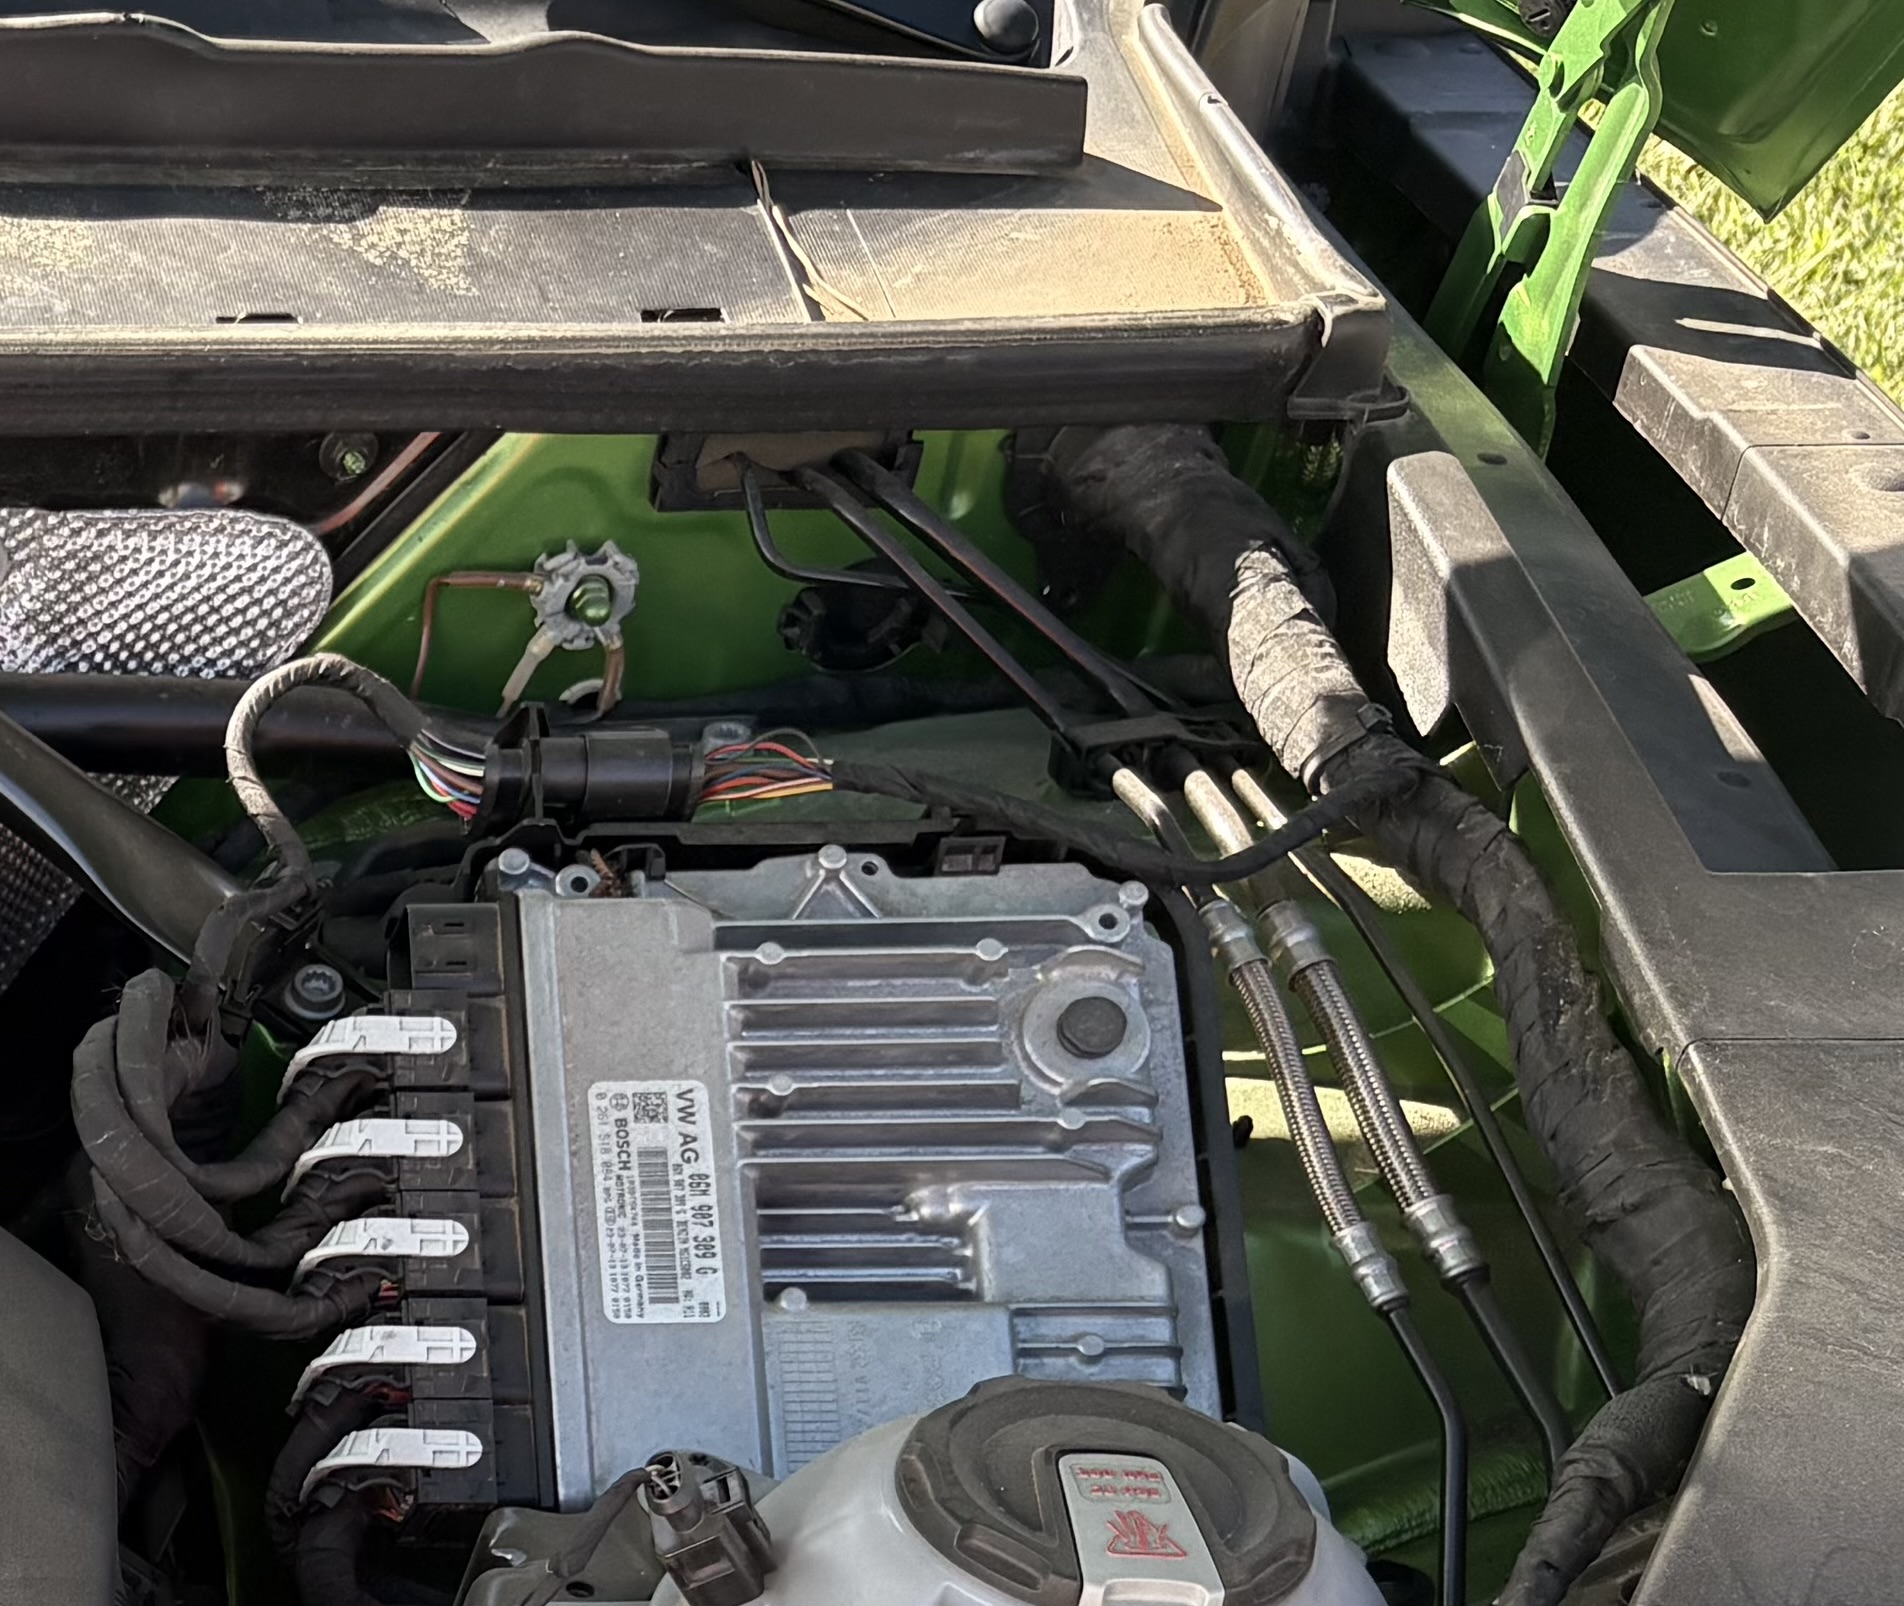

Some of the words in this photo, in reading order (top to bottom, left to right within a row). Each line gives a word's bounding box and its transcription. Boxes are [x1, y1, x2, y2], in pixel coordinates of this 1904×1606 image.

[596, 1105, 609, 1125] 261
[676, 1088, 697, 1125] VW
[614, 1118, 631, 1171] BOSCH
[678, 1132, 700, 1164] AG
[615, 1175, 627, 1219] MOTRONIC
[690, 1204, 714, 1228] 907
[692, 1235, 717, 1259] 309
[695, 1266, 719, 1275] G
[635, 1275, 644, 1319] Germany
